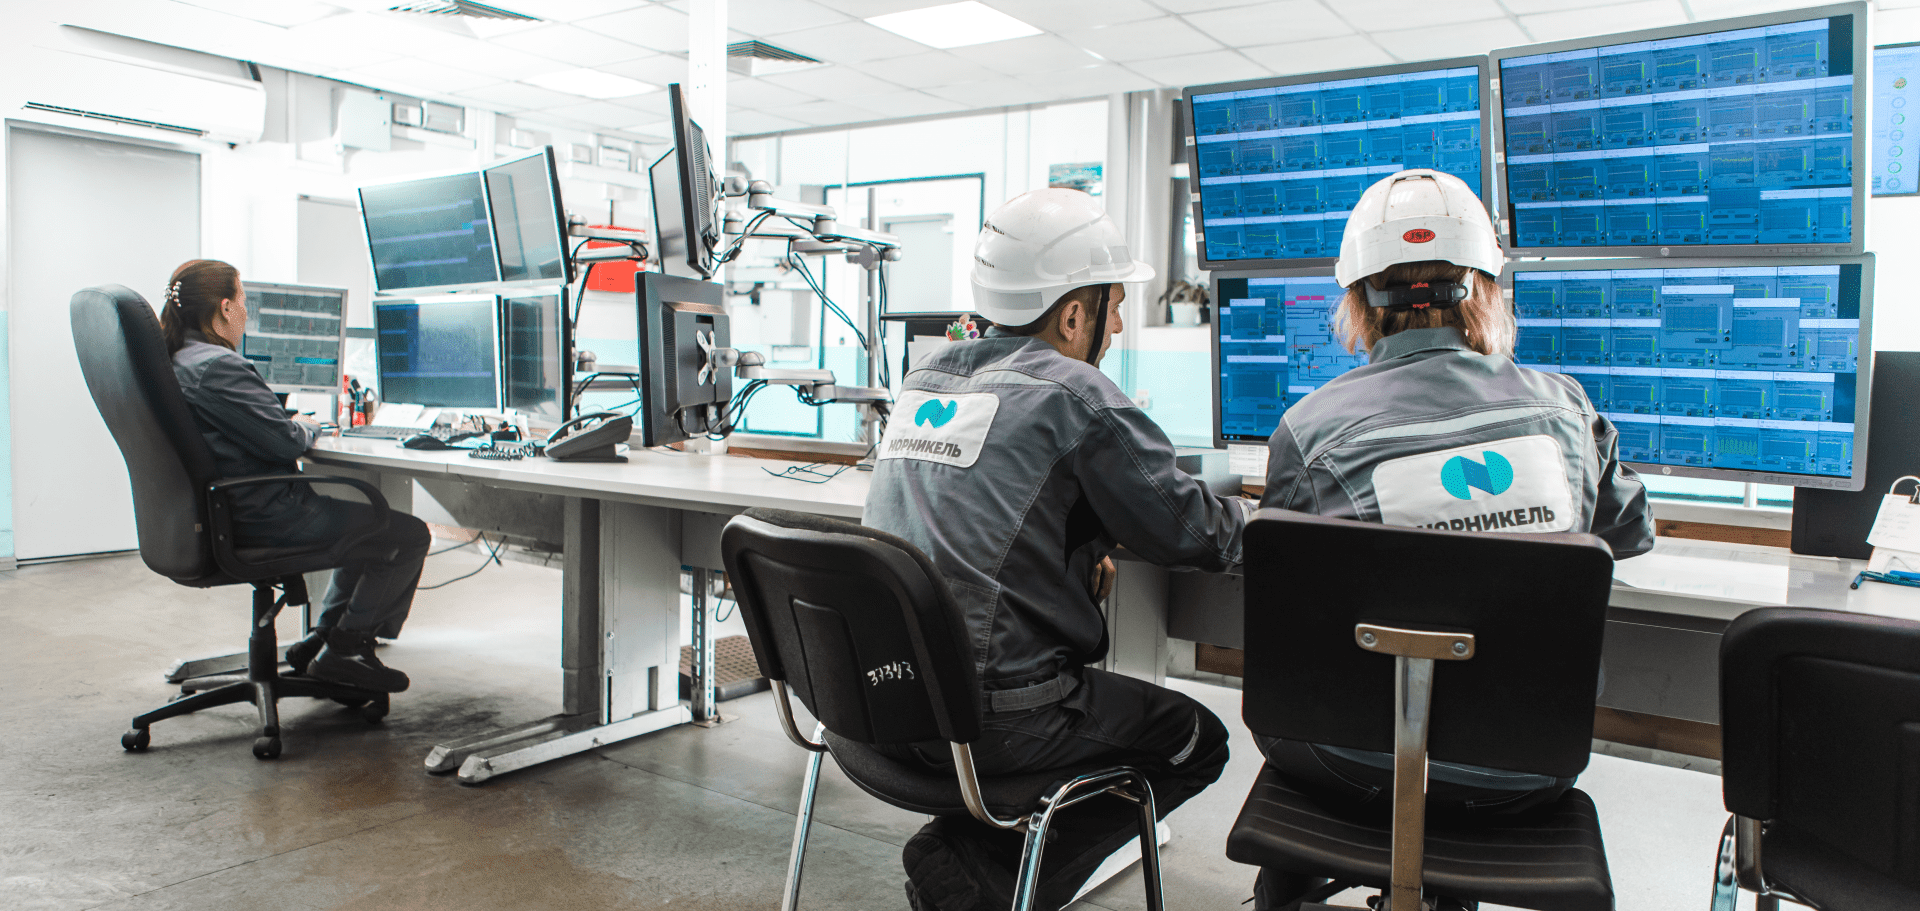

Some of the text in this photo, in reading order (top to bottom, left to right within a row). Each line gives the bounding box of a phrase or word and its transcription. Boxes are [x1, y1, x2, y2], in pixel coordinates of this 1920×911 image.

[1411, 230, 1431, 240] JSP
[888, 439, 962, 458] НОРНИКЕЛЬ
[1417, 505, 1556, 531] ОРНИКЕЛЬ
